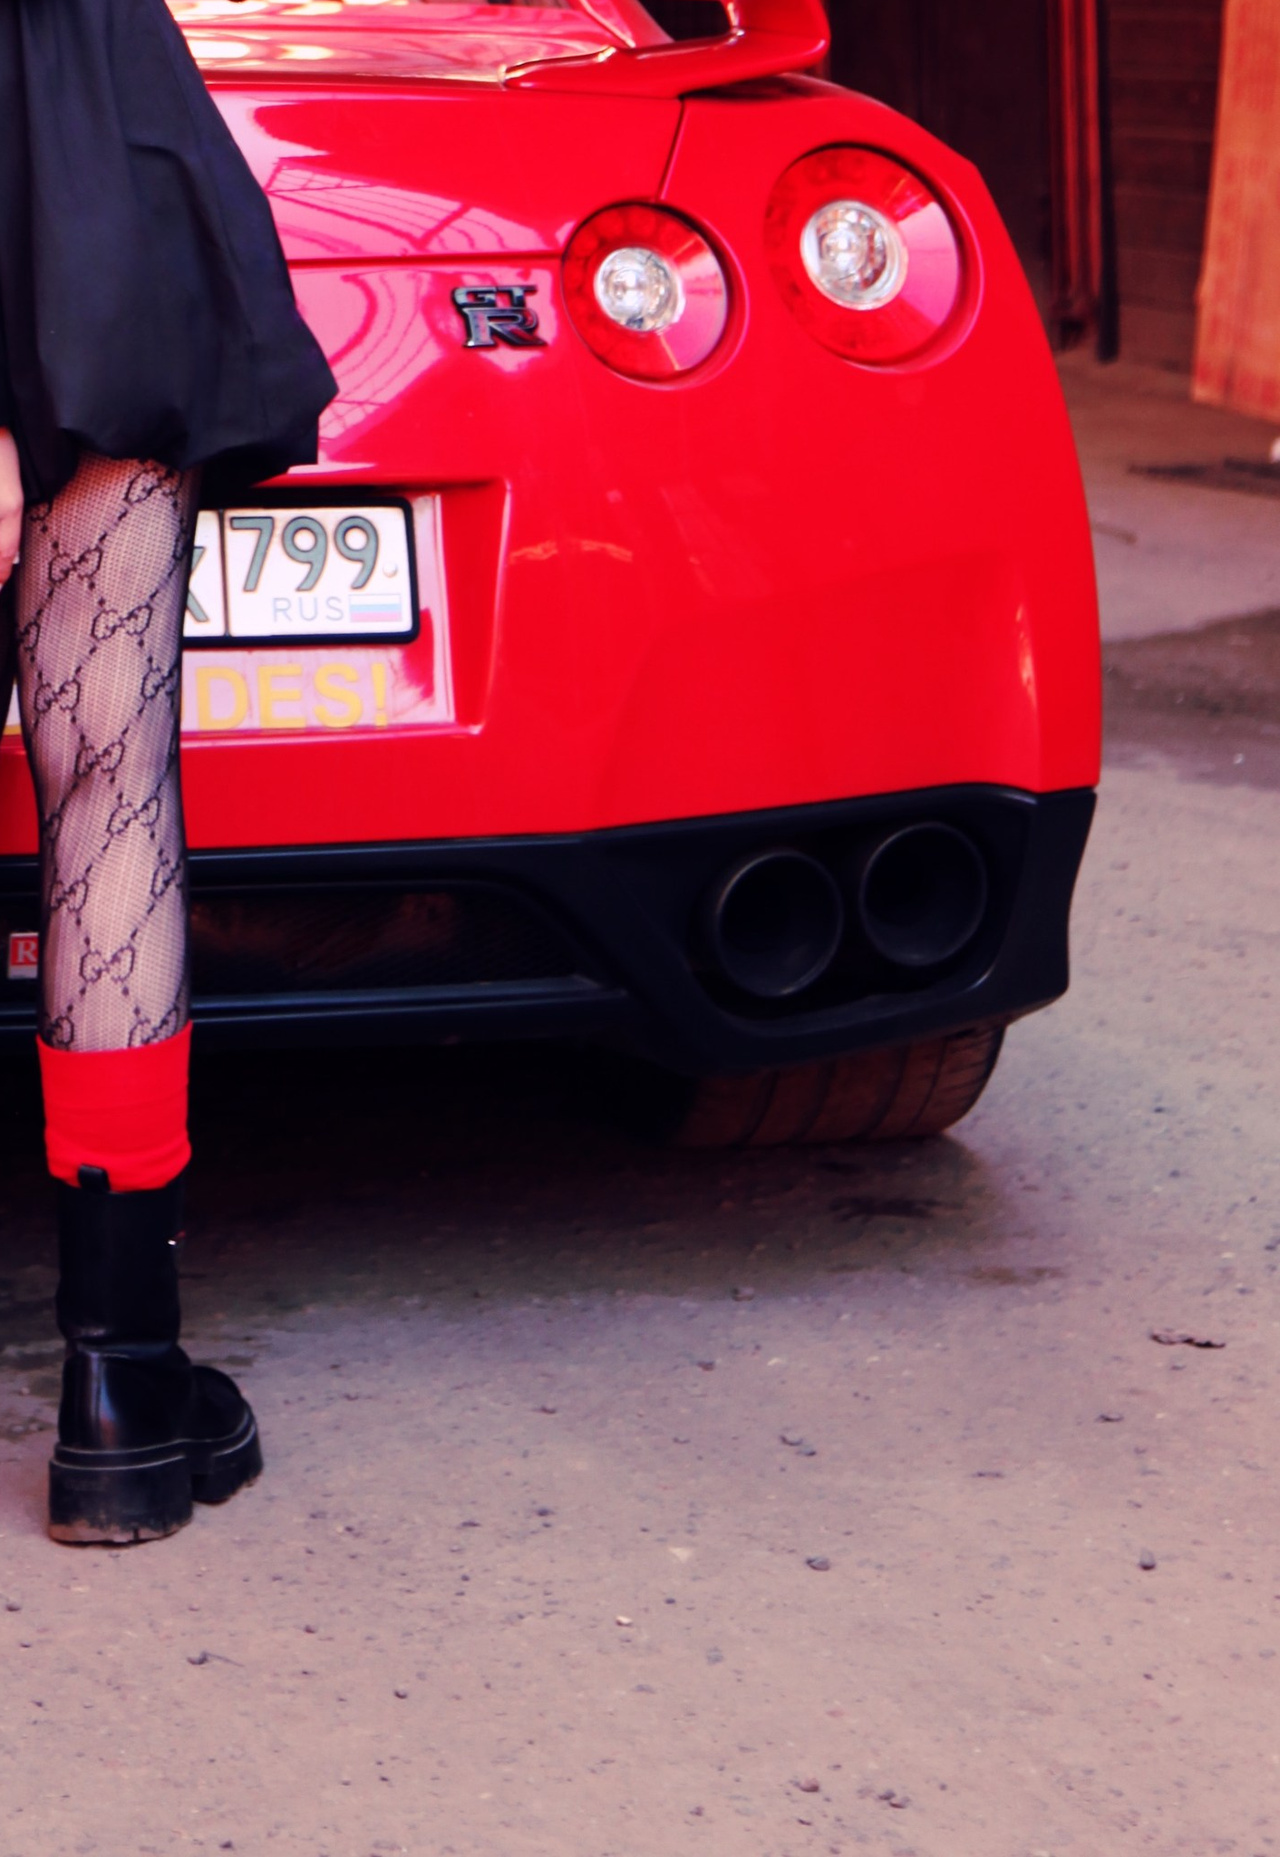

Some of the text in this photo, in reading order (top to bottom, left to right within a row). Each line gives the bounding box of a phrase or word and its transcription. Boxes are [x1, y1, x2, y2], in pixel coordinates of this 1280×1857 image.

[230, 515, 379, 593] 799
[272, 596, 345, 622] RUS
[195, 662, 388, 732] DES!
